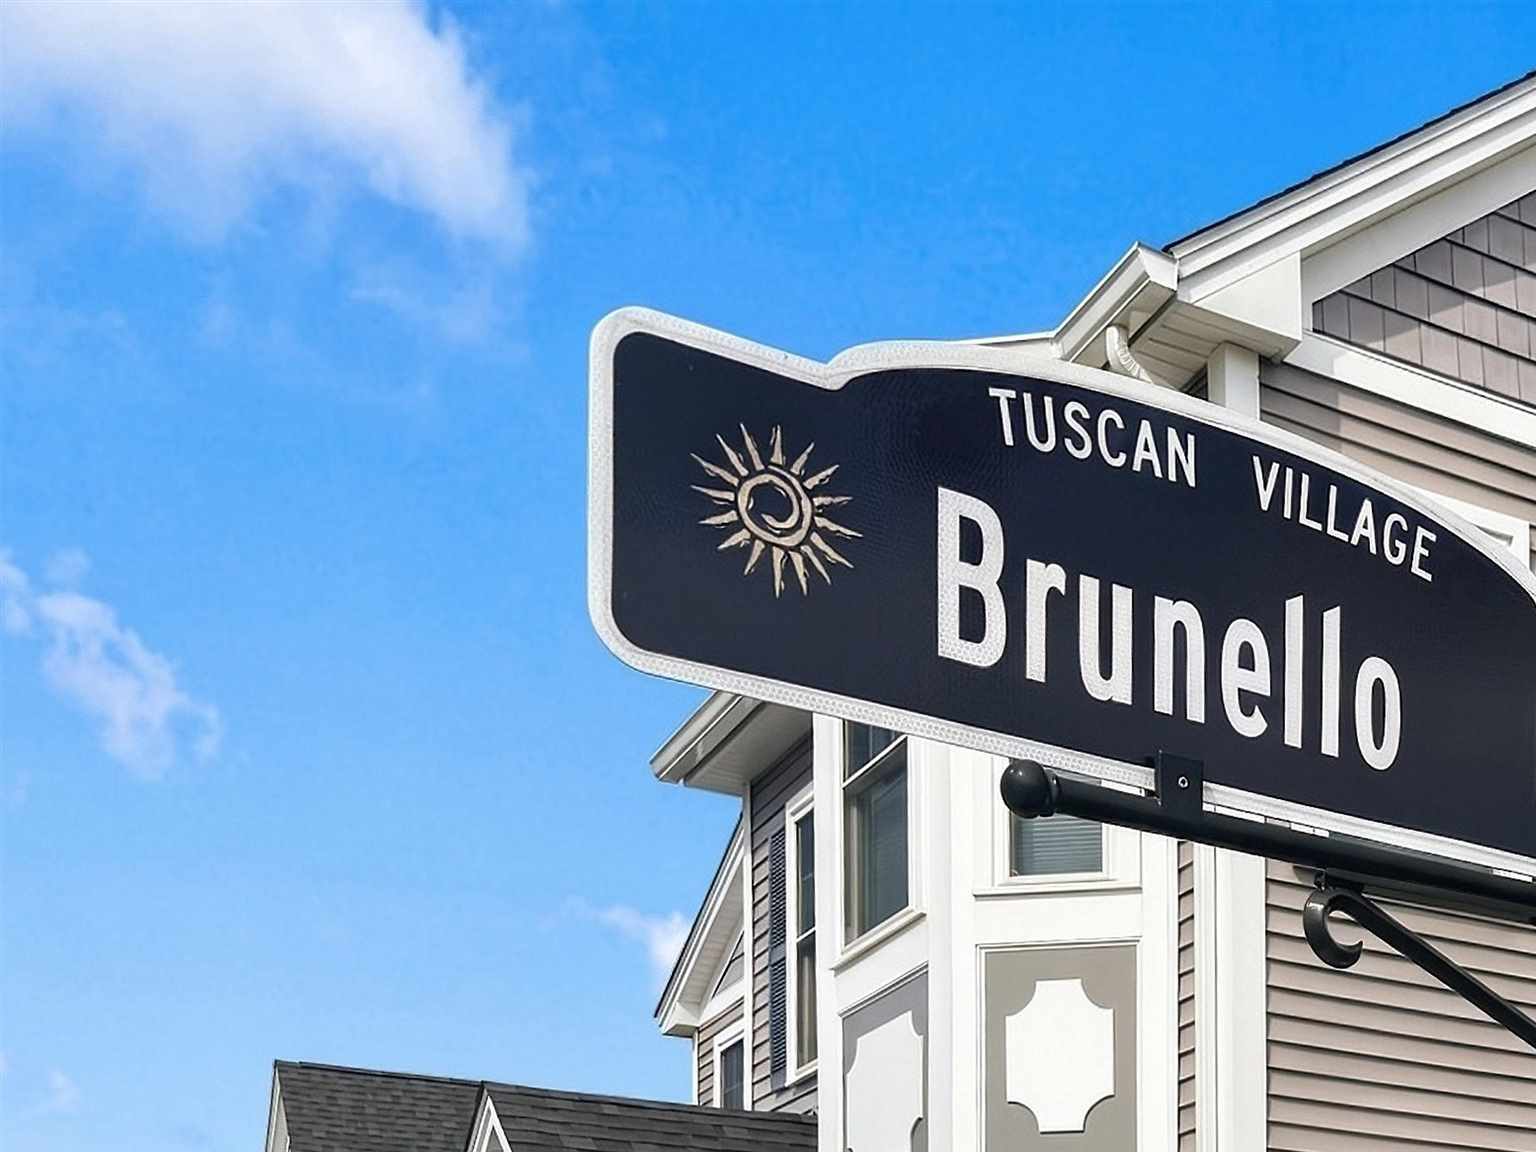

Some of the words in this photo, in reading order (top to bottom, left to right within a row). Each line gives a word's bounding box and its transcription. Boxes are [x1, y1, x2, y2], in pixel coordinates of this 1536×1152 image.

[988, 387, 1196, 488] TUSCAN
[1252, 455, 1437, 582] VILLAGE
[937, 486, 1401, 771] Brunello
